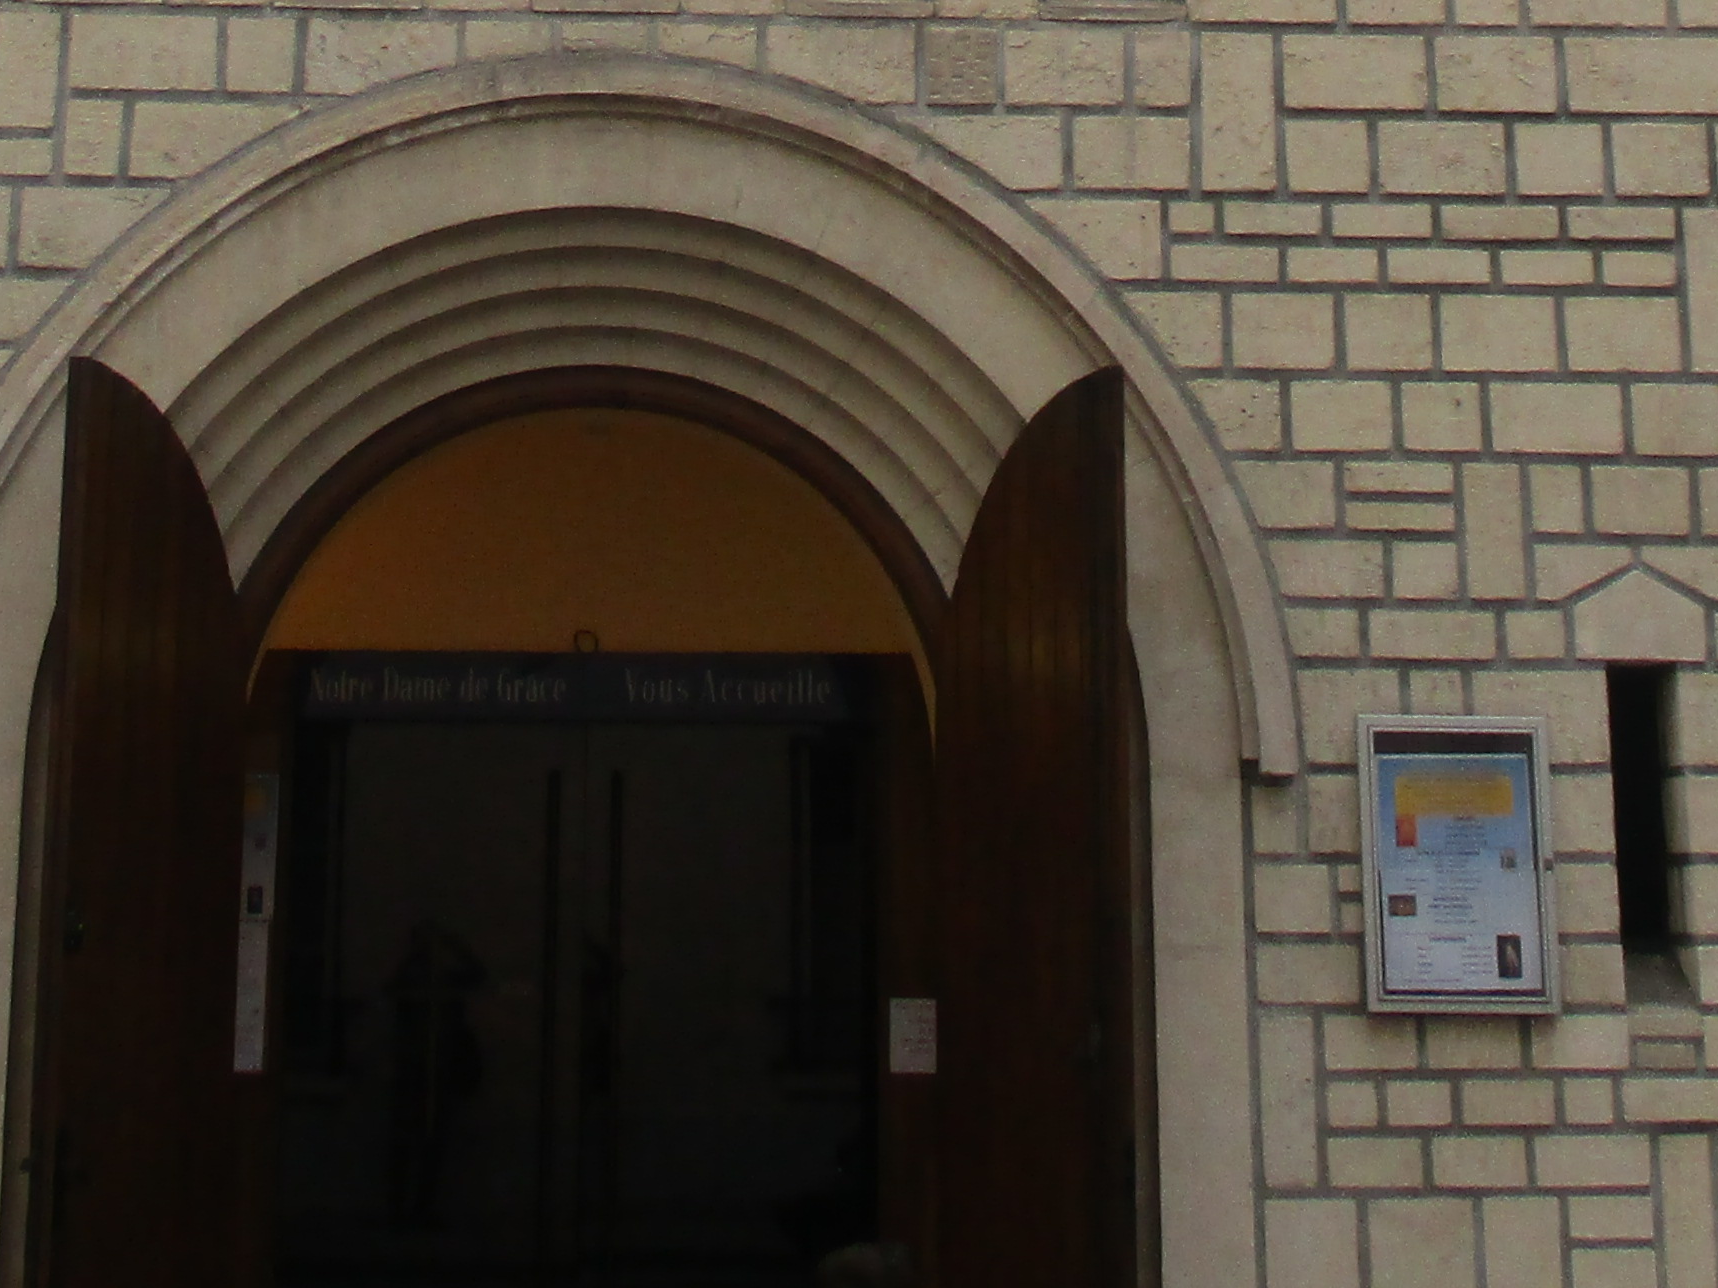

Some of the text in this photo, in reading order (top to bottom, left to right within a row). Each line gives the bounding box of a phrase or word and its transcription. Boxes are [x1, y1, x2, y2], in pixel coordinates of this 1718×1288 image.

[311, 667, 374, 702] Notre
[383, 666, 451, 702] Dame
[459, 666, 488, 702] de
[624, 667, 689, 704] Vous
[702, 667, 832, 705] Accueille
